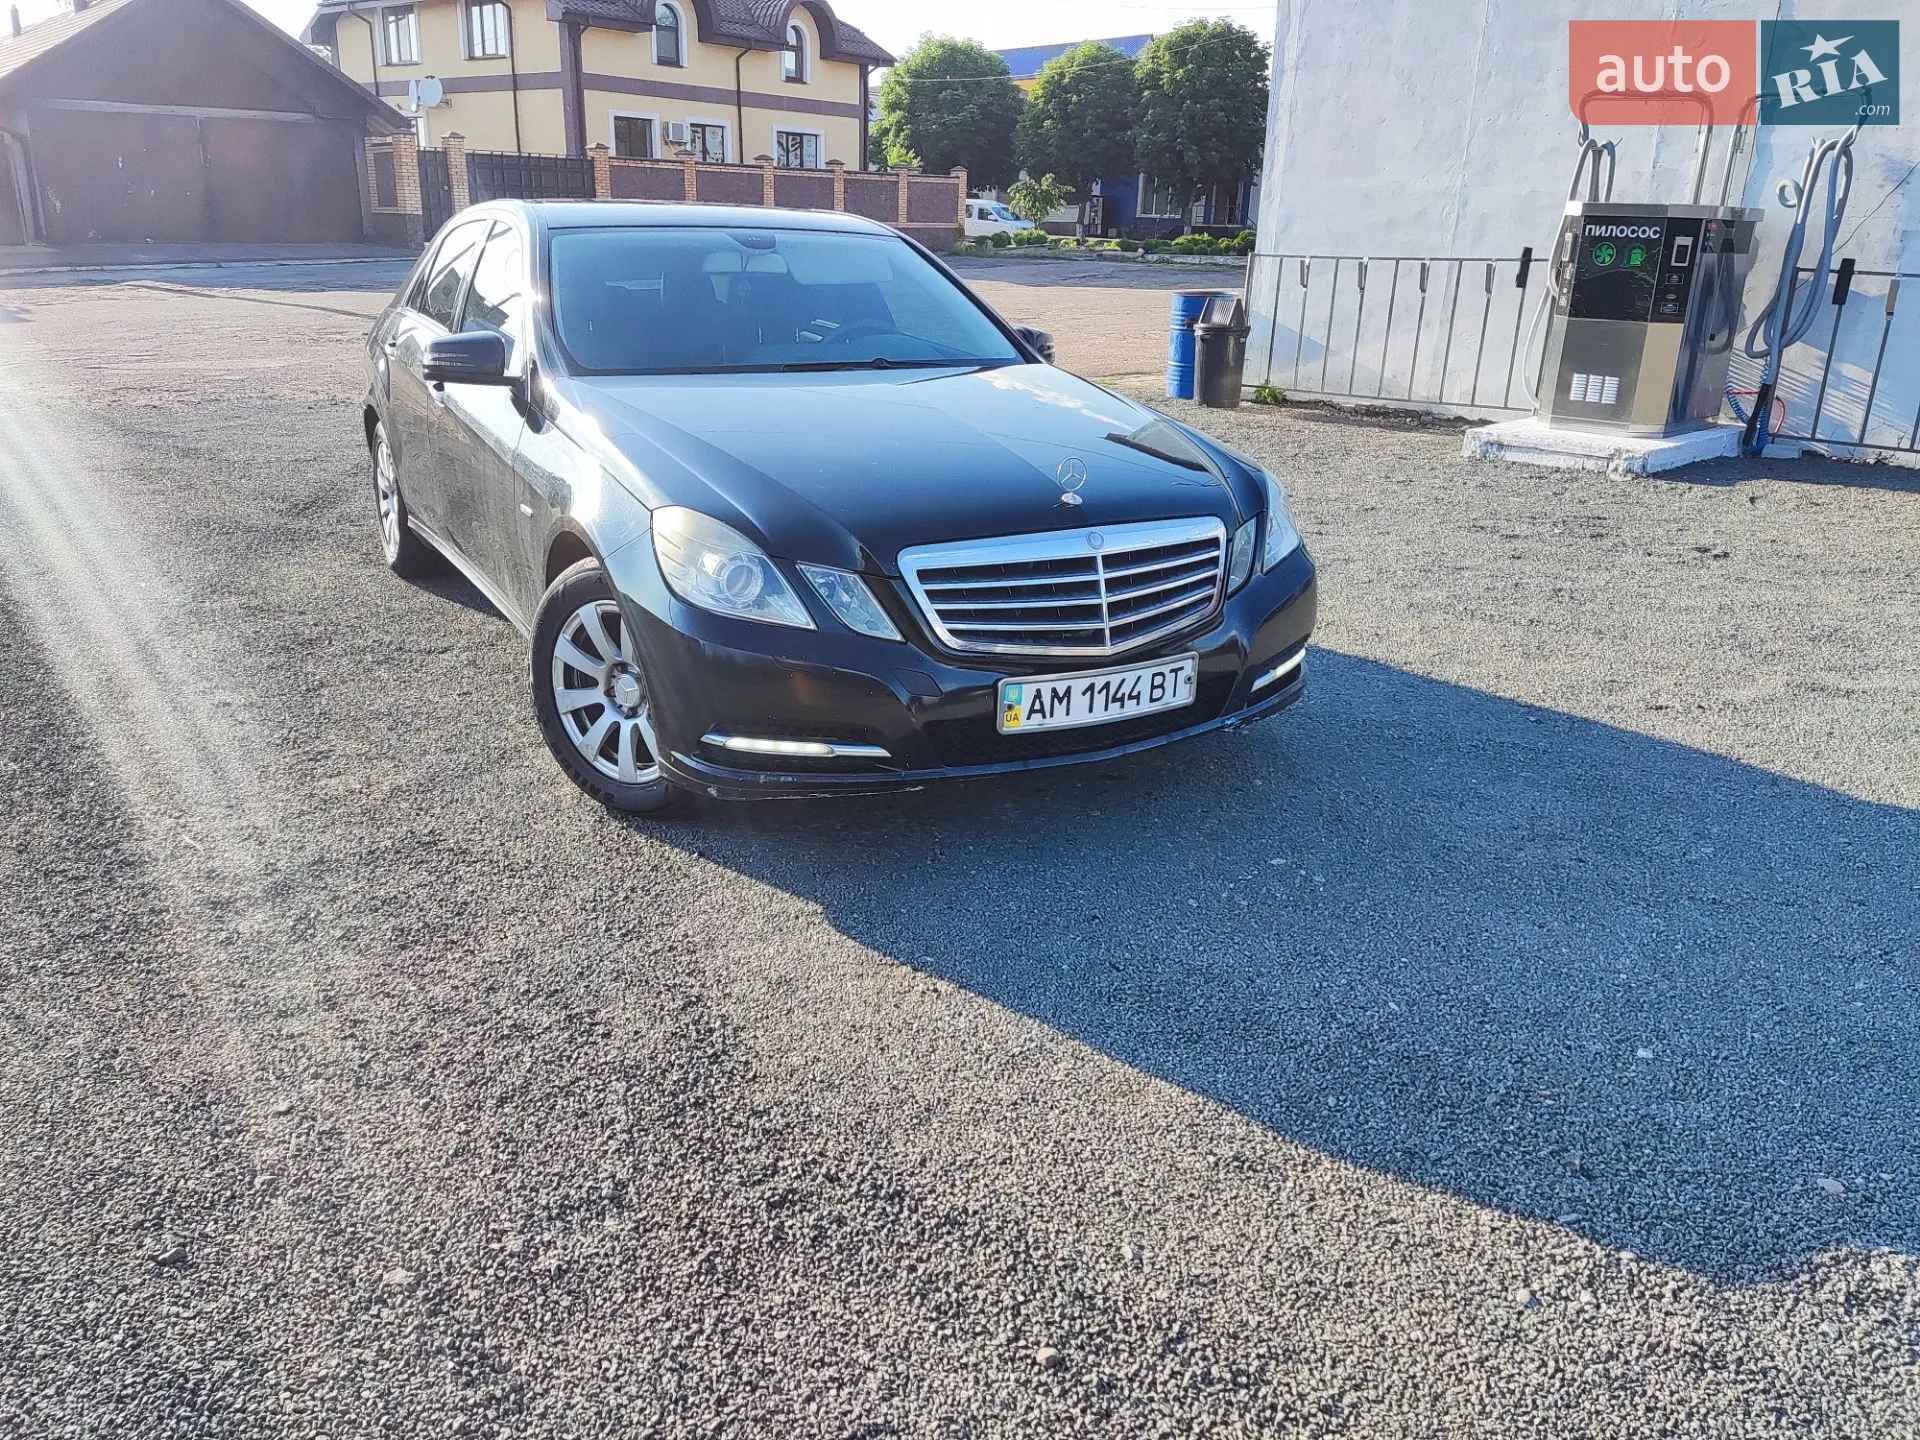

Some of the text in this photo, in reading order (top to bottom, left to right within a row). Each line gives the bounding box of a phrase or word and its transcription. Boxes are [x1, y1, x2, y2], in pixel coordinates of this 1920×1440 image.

[1585, 224, 1661, 239] ПИЛОСОС
[1026, 666, 1185, 721] AM 1144 BT
[1005, 712, 1020, 723] UA
